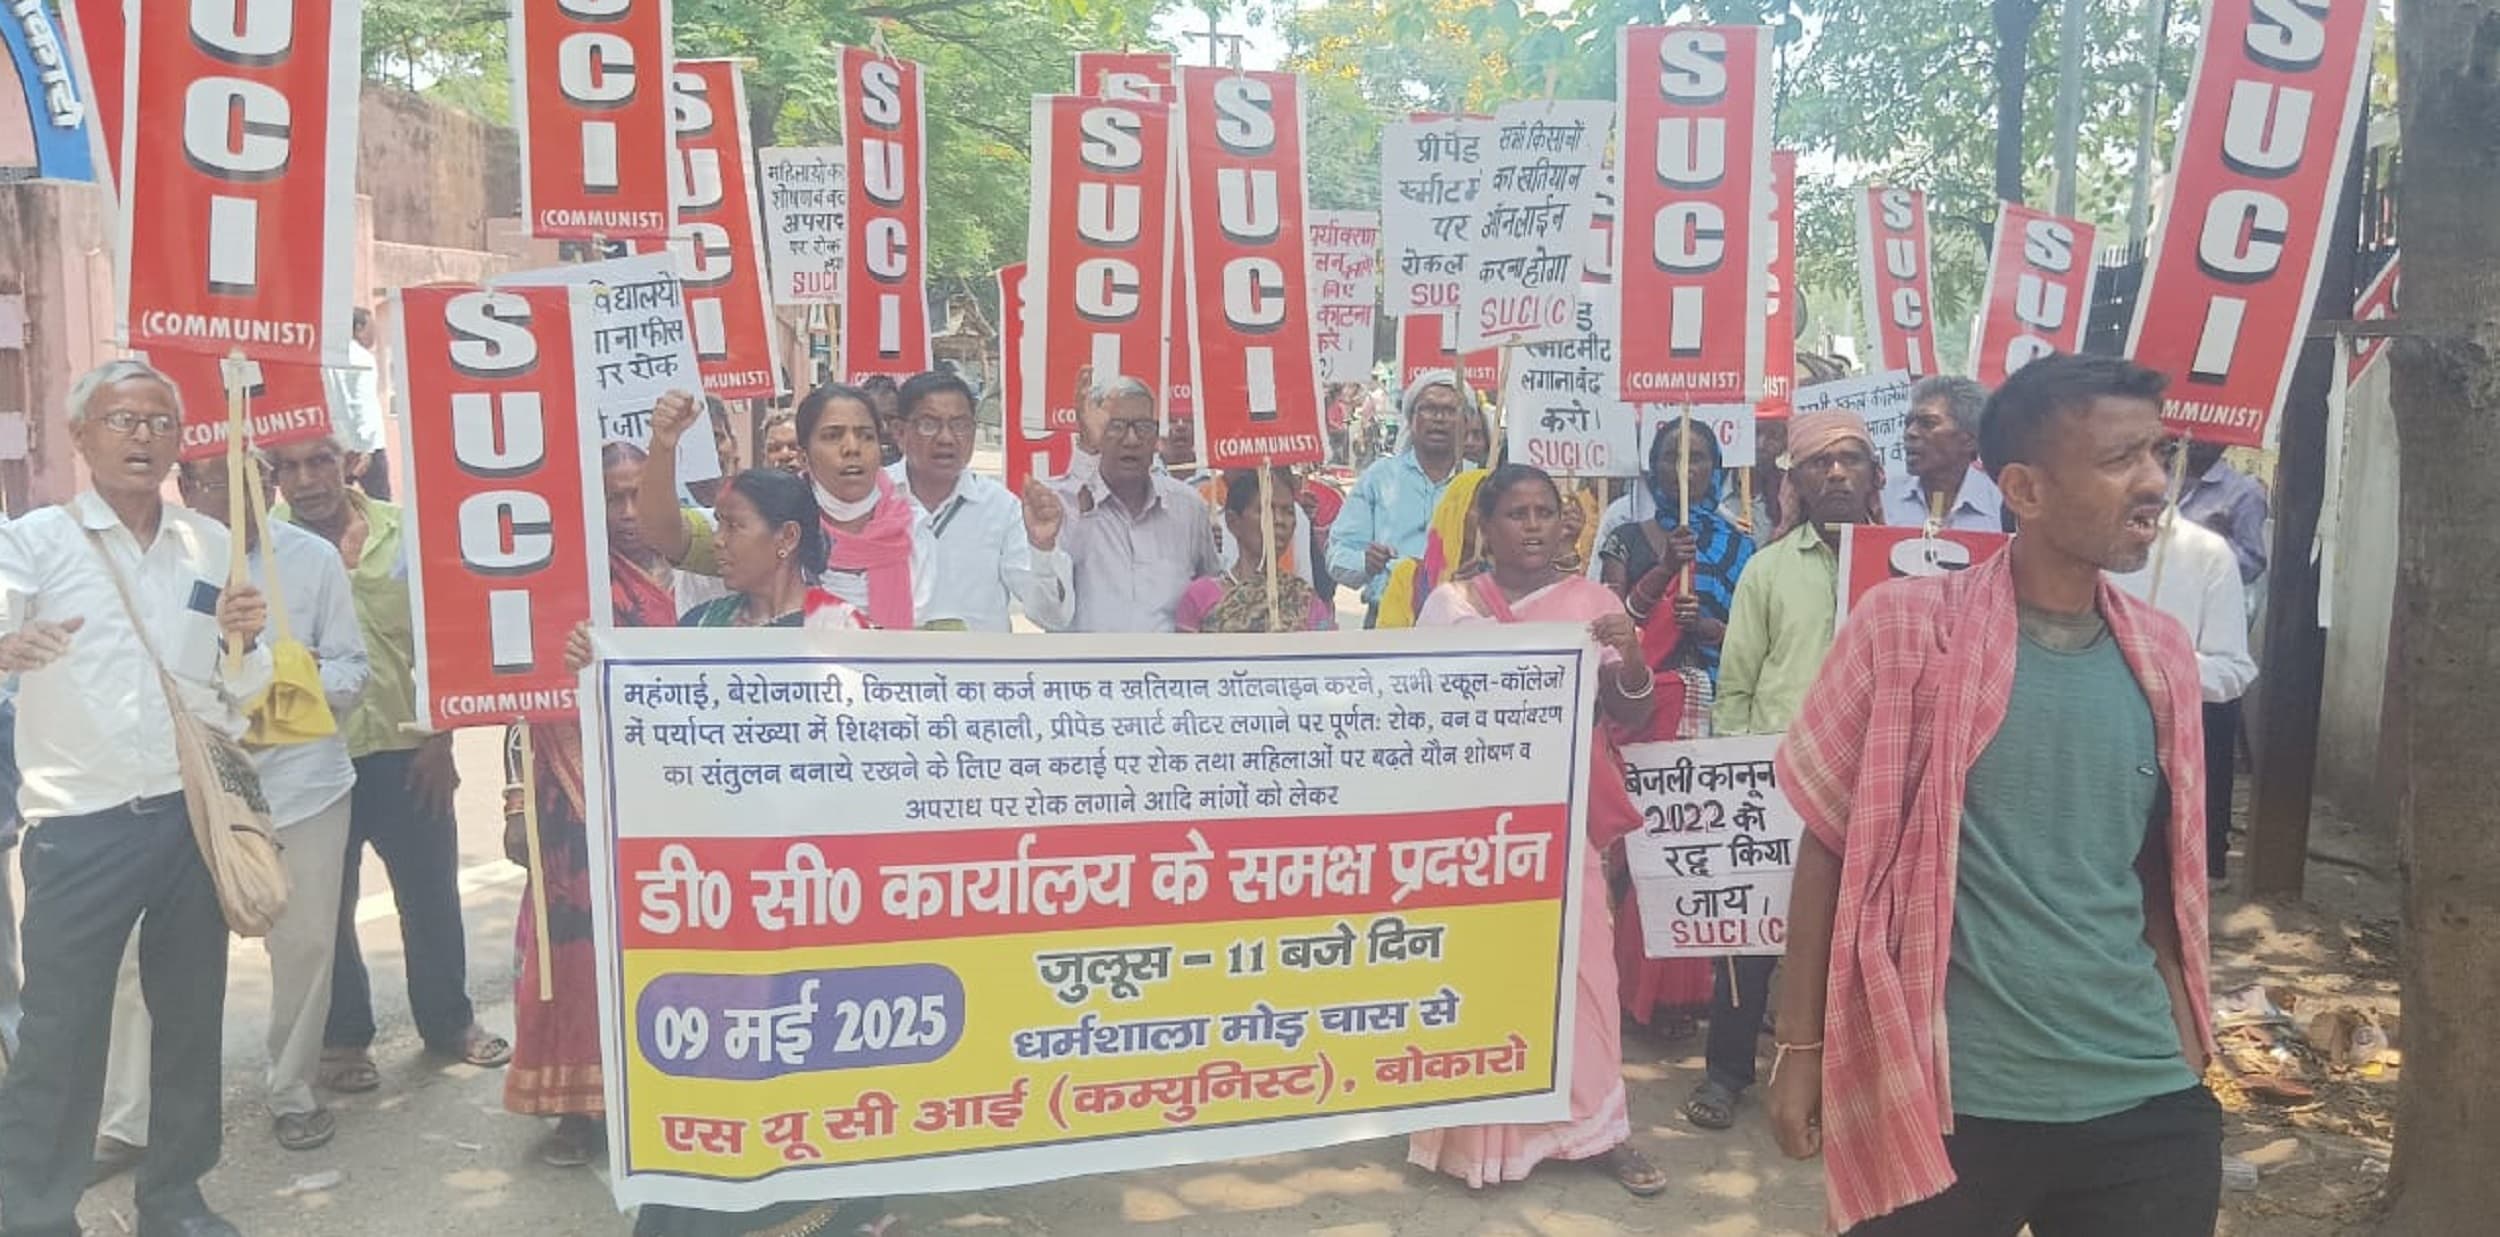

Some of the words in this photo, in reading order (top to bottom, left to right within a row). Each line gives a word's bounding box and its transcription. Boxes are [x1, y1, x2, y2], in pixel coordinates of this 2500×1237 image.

[182, 0, 293, 296] UCI
[861, 58, 909, 362] SUCI
[1652, 30, 1728, 358] SUCI
[2187, 0, 2331, 385] SUCI
[540, 209, 665, 231] (COMMUNIST)
[1431, 213, 1472, 242] पर
[1074, 106, 1143, 387] SUCI
[1212, 75, 1288, 421] SUCI
[792, 271, 838, 294] SUCI
[1410, 282, 1461, 306] SUC
[1881, 189, 1924, 379] SUCI
[141, 309, 316, 351] (COMMUNIST)
[628, 352, 678, 379] रोक
[1627, 371, 1741, 397] (COMMUNIST)
[1213, 434, 1323, 464] (COMMUNIST)
[1528, 438, 1581, 471] SUCI
[444, 290, 555, 674] SUCI
[625, 673, 719, 710] महंगाई,
[728, 673, 853, 708] बेरोजगारी,
[862, 673, 947, 702] किसानों
[956, 681, 986, 701] का
[993, 671, 1036, 702] कर्ज
[1043, 680, 1092, 701] माफ
[1098, 680, 1113, 700] व
[1120, 671, 1210, 700] खतियान
[1324, 667, 1383, 698] करने,
[1389, 666, 1433, 695] सभी
[624, 715, 645, 746] में
[652, 715, 726, 746] पर्याप्त
[732, 716, 801, 745] संख्या
[808, 713, 827, 743] में
[835, 713, 920, 743] शिक्षकों
[926, 712, 958, 741] की
[965, 711, 1043, 744] बहाली,
[1049, 710, 1106, 740] प्रीपेड
[1111, 708, 1167, 737] स्मार्ट
[1171, 708, 1226, 736] मीटर
[1230, 706, 1291, 735] लगाने
[1298, 713, 1324, 734] पर
[1388, 702, 1434, 733] रोक,
[1441, 711, 1469, 729] वन
[1475, 709, 1488, 728] व
[1494, 698, 1564, 726] पर्यावरण
[662, 764, 693, 786] का
[701, 757, 781, 794] संतुलन
[790, 753, 854, 784] बनाये
[862, 750, 919, 782] रखने
[926, 750, 949, 780] के
[956, 750, 1002, 780] लिए
[1008, 757, 1042, 778] वन
[1048, 745, 1108, 780] कटाई
[1115, 754, 1142, 776] पर
[1148, 745, 1188, 774] रोक
[1194, 753, 1236, 774] तथा
[1242, 741, 1333, 774] महिलाओं
[1340, 749, 1366, 769] पर
[1371, 739, 1415, 772] बढ़ते
[1420, 738, 1457, 766] यौन
[1464, 736, 1516, 765] शोषण
[1519, 741, 1532, 761] व
[1697, 761, 1776, 800] कानून
[905, 797, 982, 821] अपराध
[990, 795, 1020, 818] पर
[1024, 786, 1069, 816] रोक
[1074, 783, 1136, 815] लगाने
[1143, 782, 1193, 812] आदि
[1198, 779, 1250, 810] मांगों
[1255, 779, 1283, 808] को
[1288, 777, 1340, 807] लेकर
[1645, 799, 1727, 835] 2022
[1732, 801, 1767, 832] को
[879, 833, 1136, 922] कार्यालय
[1150, 828, 1215, 906] के
[1227, 832, 1377, 903] समक्ष
[1388, 812, 1554, 904] प्रदर्शन
[1726, 834, 1793, 868] किया
[1675, 883, 1754, 918] जाय
[1670, 918, 1748, 945] SUCI
[1036, 946, 1172, 1001] जुलूस
[1227, 939, 1266, 974] 11
[1280, 923, 1358, 970] बजे
[1367, 916, 1445, 963] दिन
[654, 1005, 709, 1061] 09
[723, 979, 821, 1065] मई
[832, 994, 948, 1055] 2025
[1013, 1013, 1211, 1060] धर्मशाला
[1221, 1002, 1308, 1047] मोड़
[1319, 1001, 1409, 1033] चास
[1419, 987, 1461, 1026] से
[661, 1115, 748, 1155] एस
[762, 1110, 822, 1161] यू
[824, 1090, 898, 1140] सी
[913, 1077, 1030, 1129] आई
[1375, 1034, 1528, 1086] बोकारो
